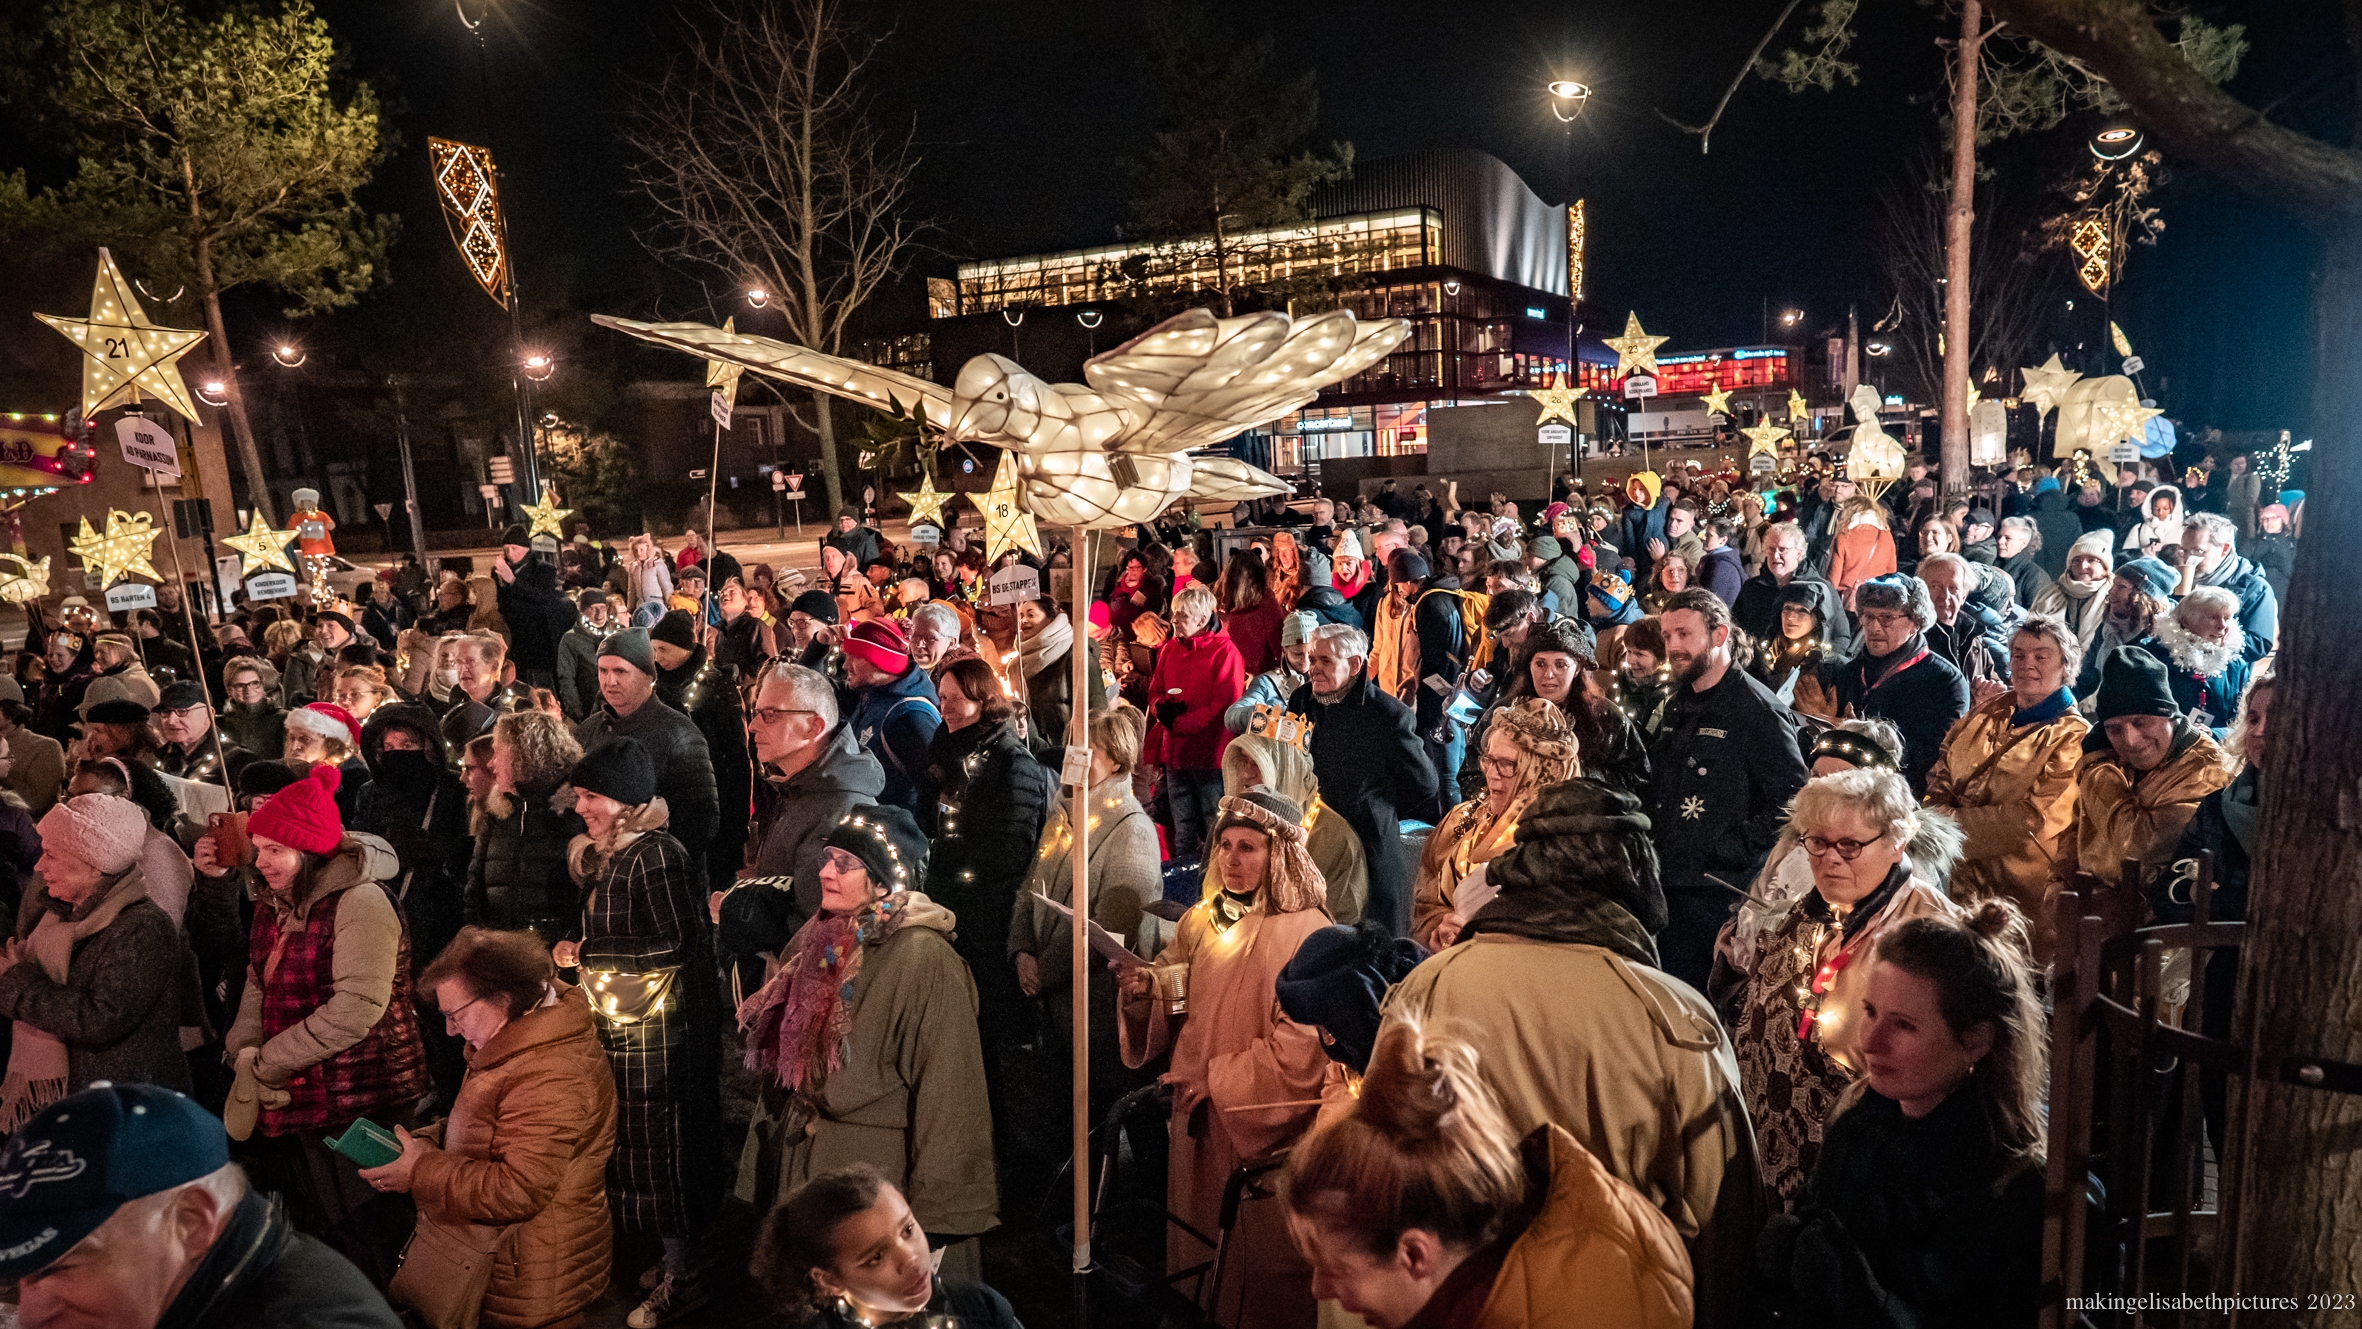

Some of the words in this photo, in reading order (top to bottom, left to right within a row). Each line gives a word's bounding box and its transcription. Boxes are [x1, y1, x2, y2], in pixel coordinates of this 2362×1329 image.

[105, 337, 130, 359] 21
[1627, 345, 1638, 354] 23
[134, 431, 156, 446] KOOR
[125, 444, 135, 457] AD
[134, 446, 175, 467] PARNASSUM
[995, 503, 1009, 518] 18
[258, 541, 267, 551] 5
[254, 579, 286, 588] KINDERKOOR
[992, 584, 1001, 595] BS
[110, 596, 120, 604] BS
